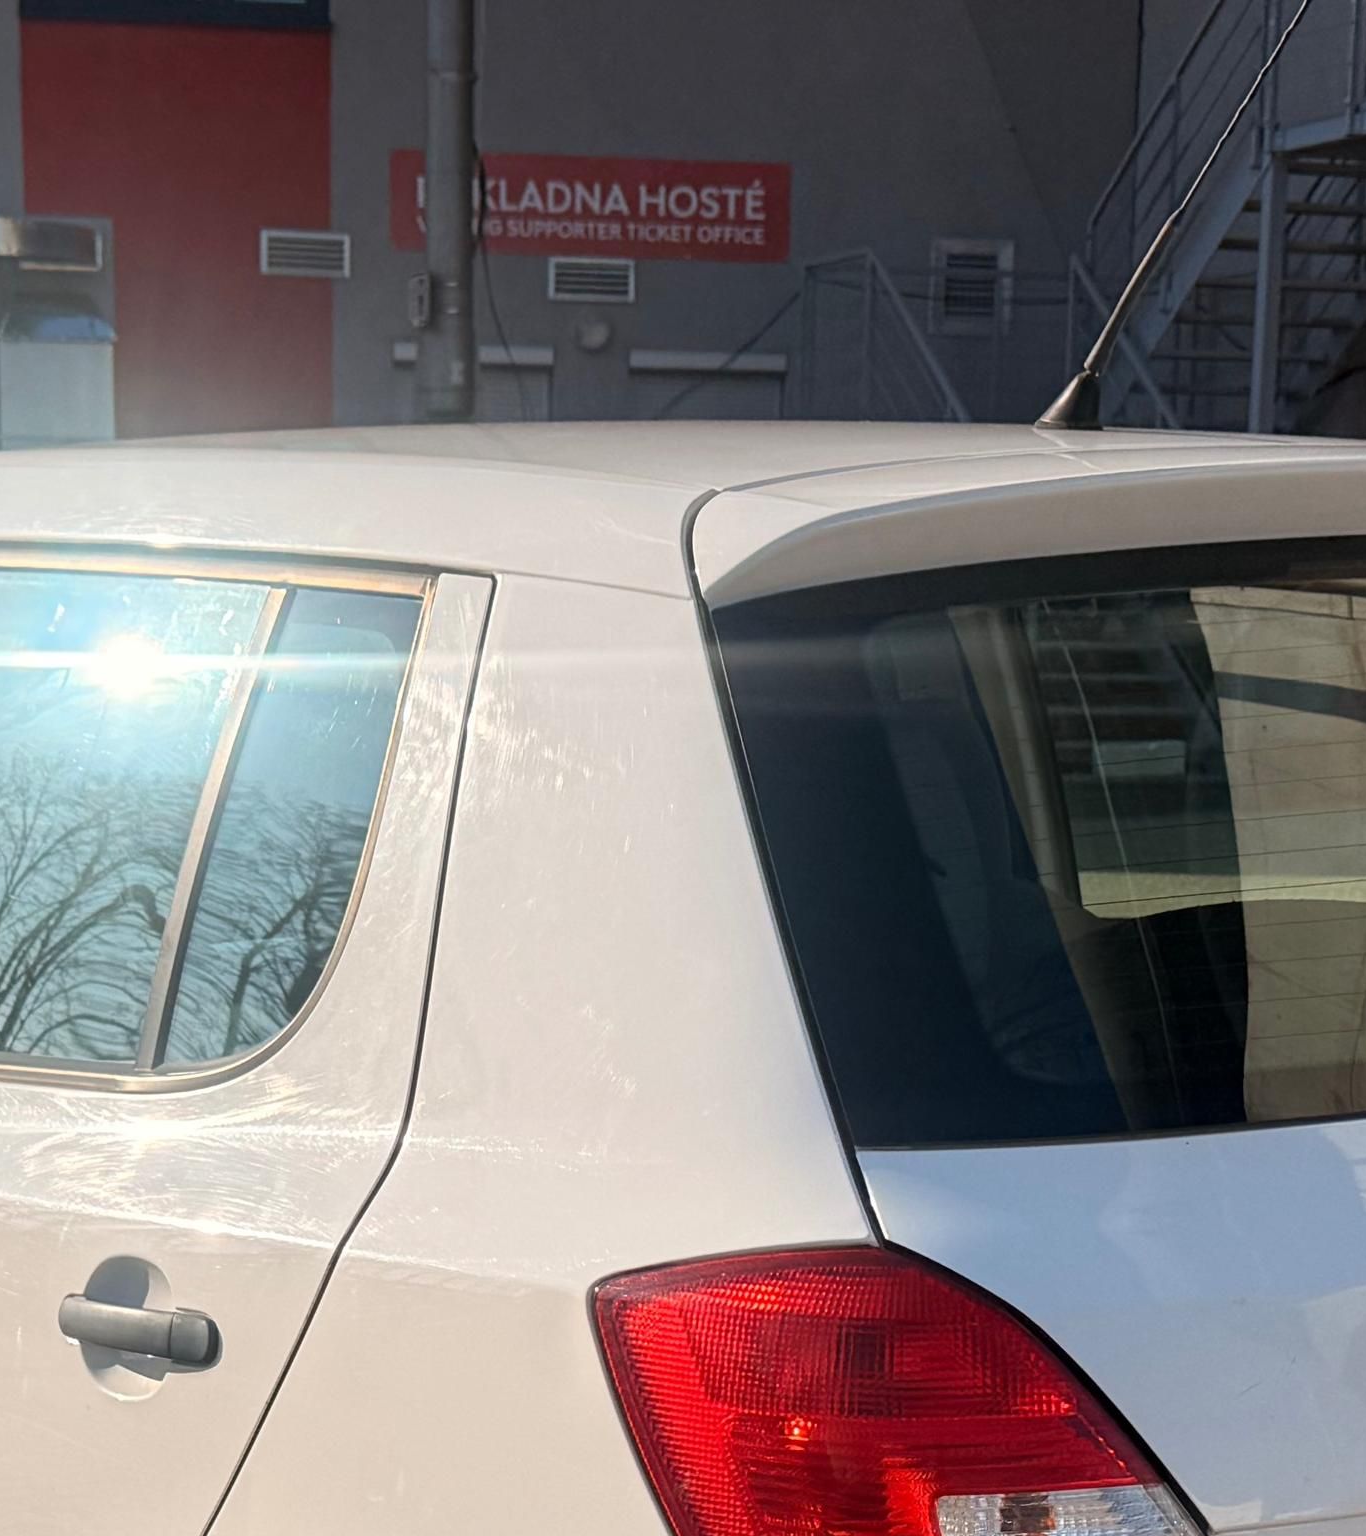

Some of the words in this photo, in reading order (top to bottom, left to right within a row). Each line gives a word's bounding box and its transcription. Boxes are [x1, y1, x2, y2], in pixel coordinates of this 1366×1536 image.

[416, 175, 630, 215] KLADNA
[639, 179, 766, 221] HOSTÉ
[507, 218, 623, 241] SUPPORTER
[628, 222, 692, 243] TICKET
[698, 224, 766, 245] OFFICE
